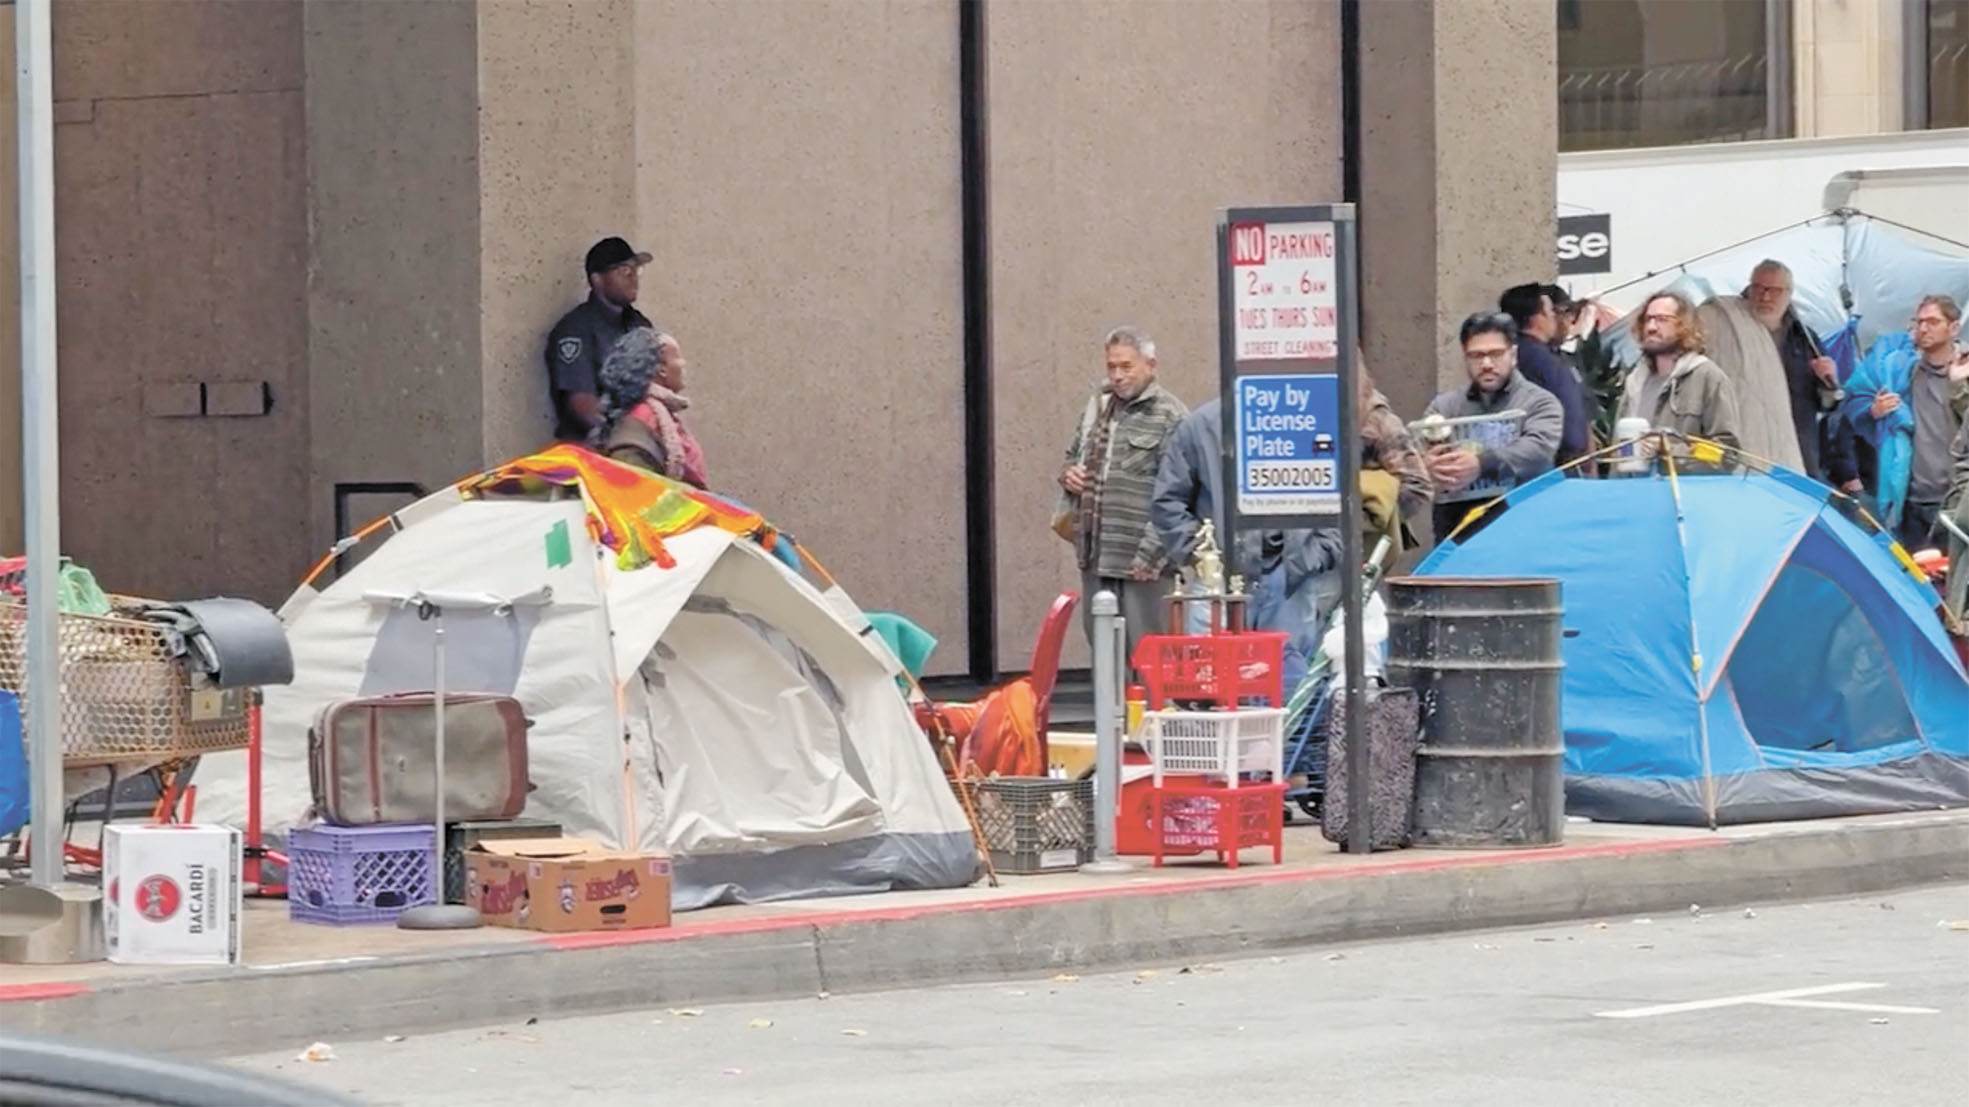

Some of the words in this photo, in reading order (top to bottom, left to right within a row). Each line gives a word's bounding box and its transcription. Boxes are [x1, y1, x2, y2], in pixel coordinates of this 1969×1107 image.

[1236, 226, 1263, 261] NO
[1270, 233, 1333, 259] PARKING
[1239, 307, 1267, 329] TUES
[1272, 307, 1307, 328] THURS
[1312, 306, 1335, 327] SUN
[1244, 341, 1279, 354] STREET
[1284, 340, 1333, 354] CLEANING
[1244, 385, 1280, 412] Pay
[1285, 383, 1310, 412] by
[1246, 409, 1317, 431] License
[1246, 433, 1295, 457] Plate
[1250, 467, 1332, 487] 35002005
[185, 864, 204, 934] BACARDÍ
